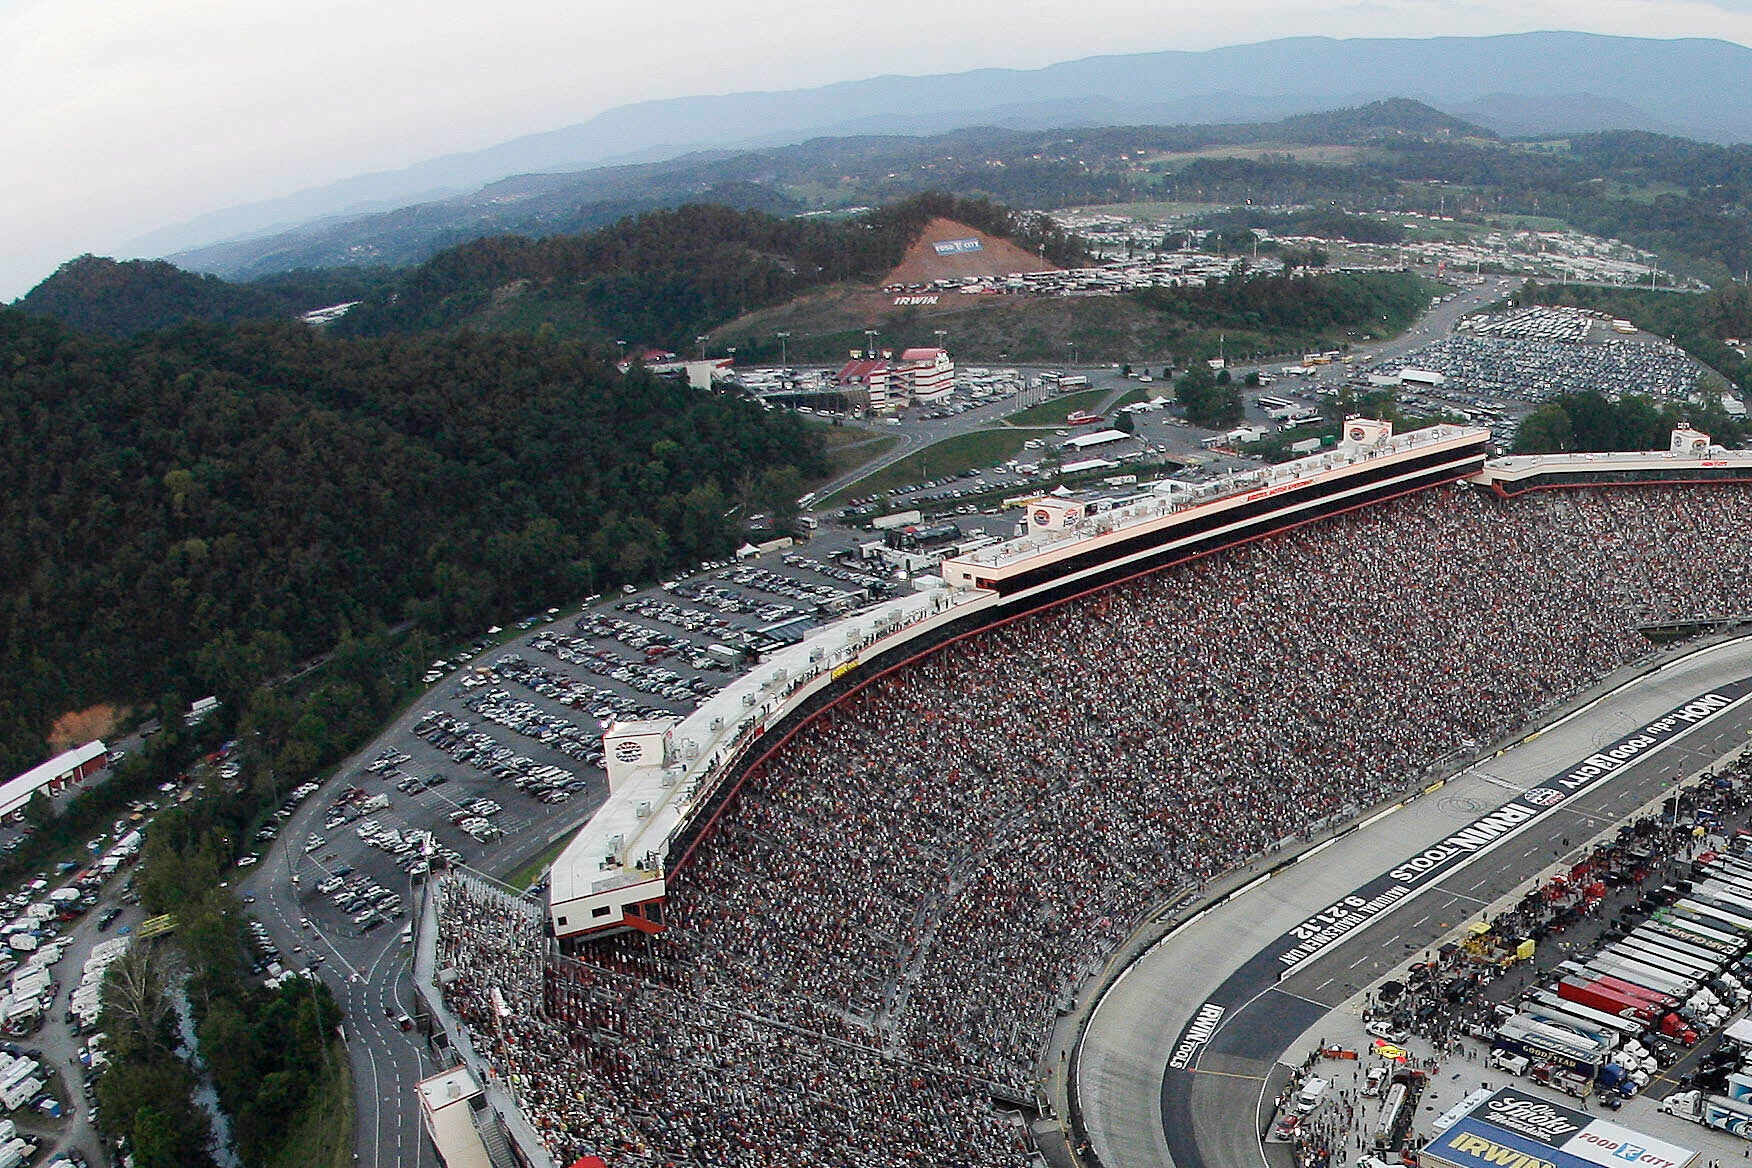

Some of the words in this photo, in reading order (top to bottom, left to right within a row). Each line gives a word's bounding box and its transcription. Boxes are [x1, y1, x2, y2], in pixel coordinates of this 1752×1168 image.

[894, 296, 938, 305] IRWIN
[1610, 734, 1657, 760] FOOD
[1559, 765, 1600, 789] CITY
[1451, 803, 1537, 850] IRWIN
[1389, 844, 1456, 882] TOOLS
[1289, 895, 1368, 940] 9.21.12
[1185, 1003, 1224, 1042] IRWIN
[1169, 1040, 1197, 1069] TOOLS
[1522, 1045, 1577, 1068] GOODYEAR
[1487, 1097, 1579, 1136] Smoky
[1579, 1132, 1618, 1151] FOOD
